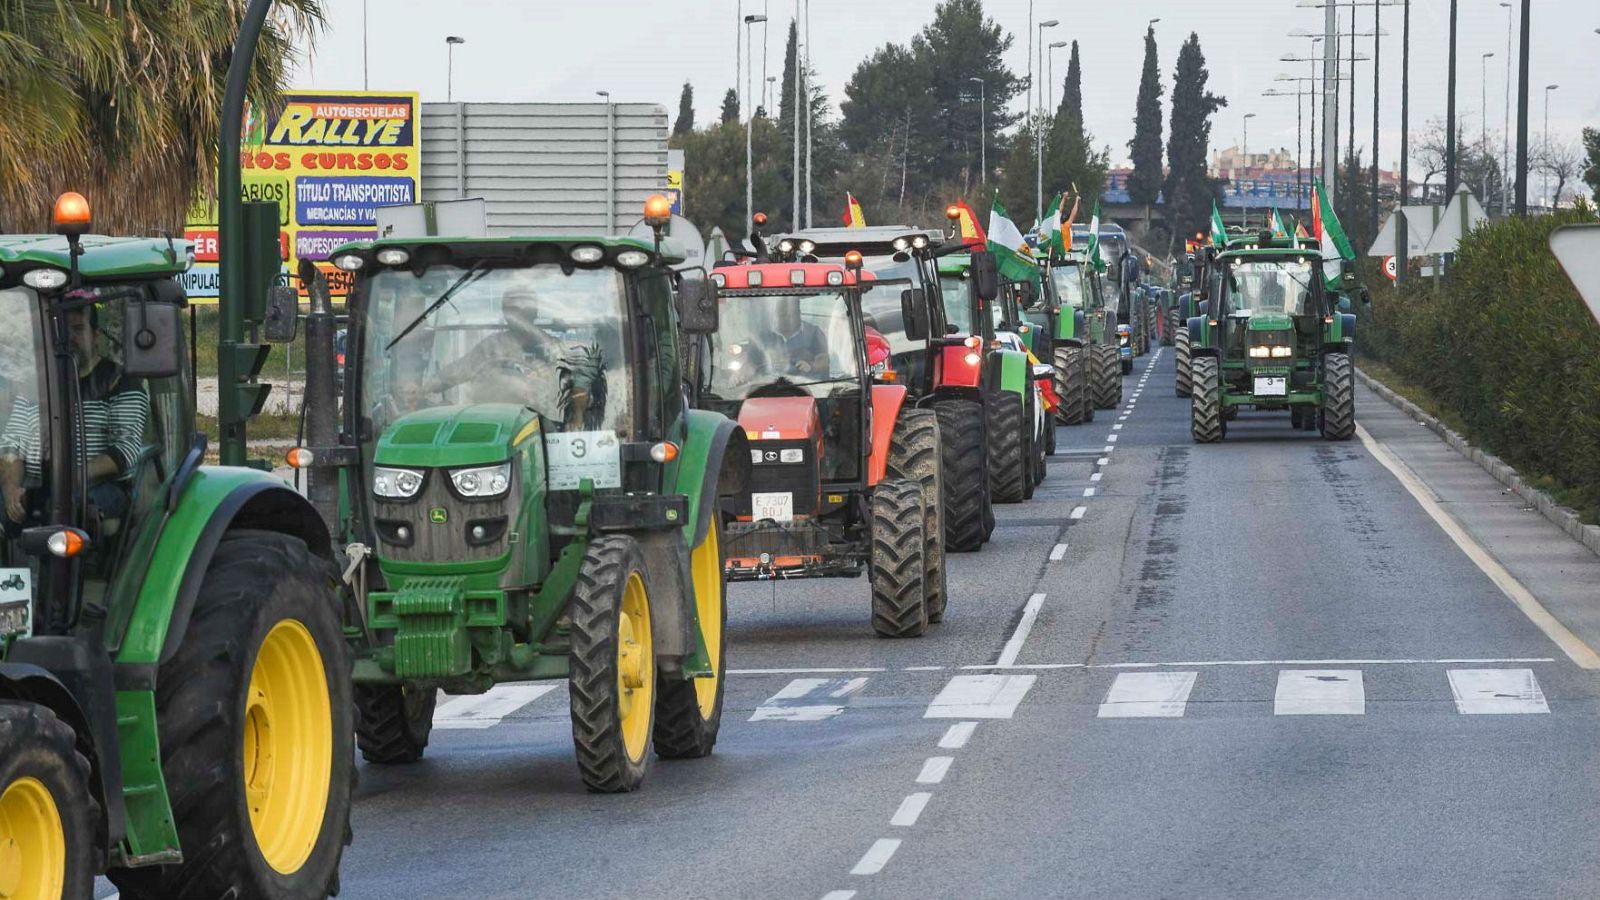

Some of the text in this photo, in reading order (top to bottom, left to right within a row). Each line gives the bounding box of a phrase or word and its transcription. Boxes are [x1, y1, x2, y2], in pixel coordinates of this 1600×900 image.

[316, 106, 406, 118] AUTOESCUELAS
[270, 105, 406, 144] RALLYE
[241, 152, 408, 170] ROS CURSOS
[241, 183, 283, 200] ARIOS
[297, 179, 411, 202] TÍTULO TRANSPORTISTA
[307, 205, 376, 220] MERCANCÍAS Y VIA
[571, 438, 586, 458] 3
